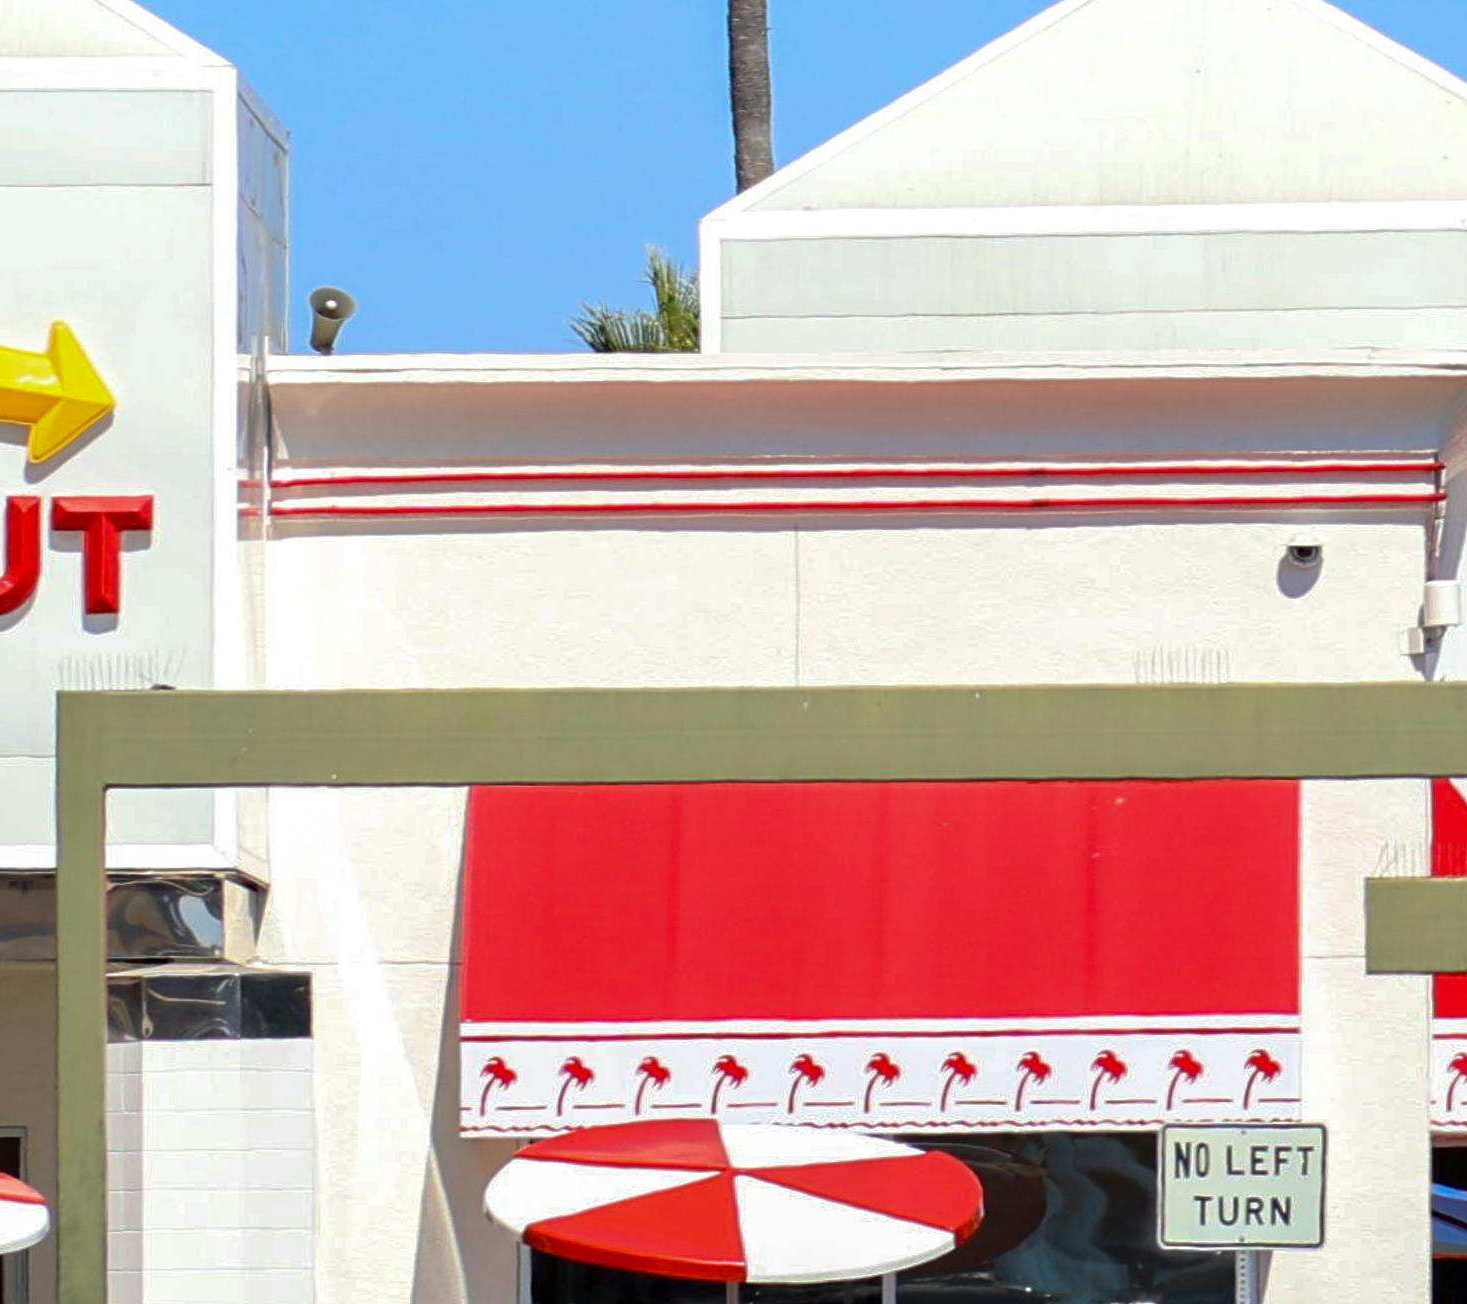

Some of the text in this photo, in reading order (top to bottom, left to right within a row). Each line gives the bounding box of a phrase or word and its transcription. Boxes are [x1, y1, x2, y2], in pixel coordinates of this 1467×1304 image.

[1174, 1141, 1315, 1179] NO LEFT
[1193, 1195, 1292, 1226] TURN
